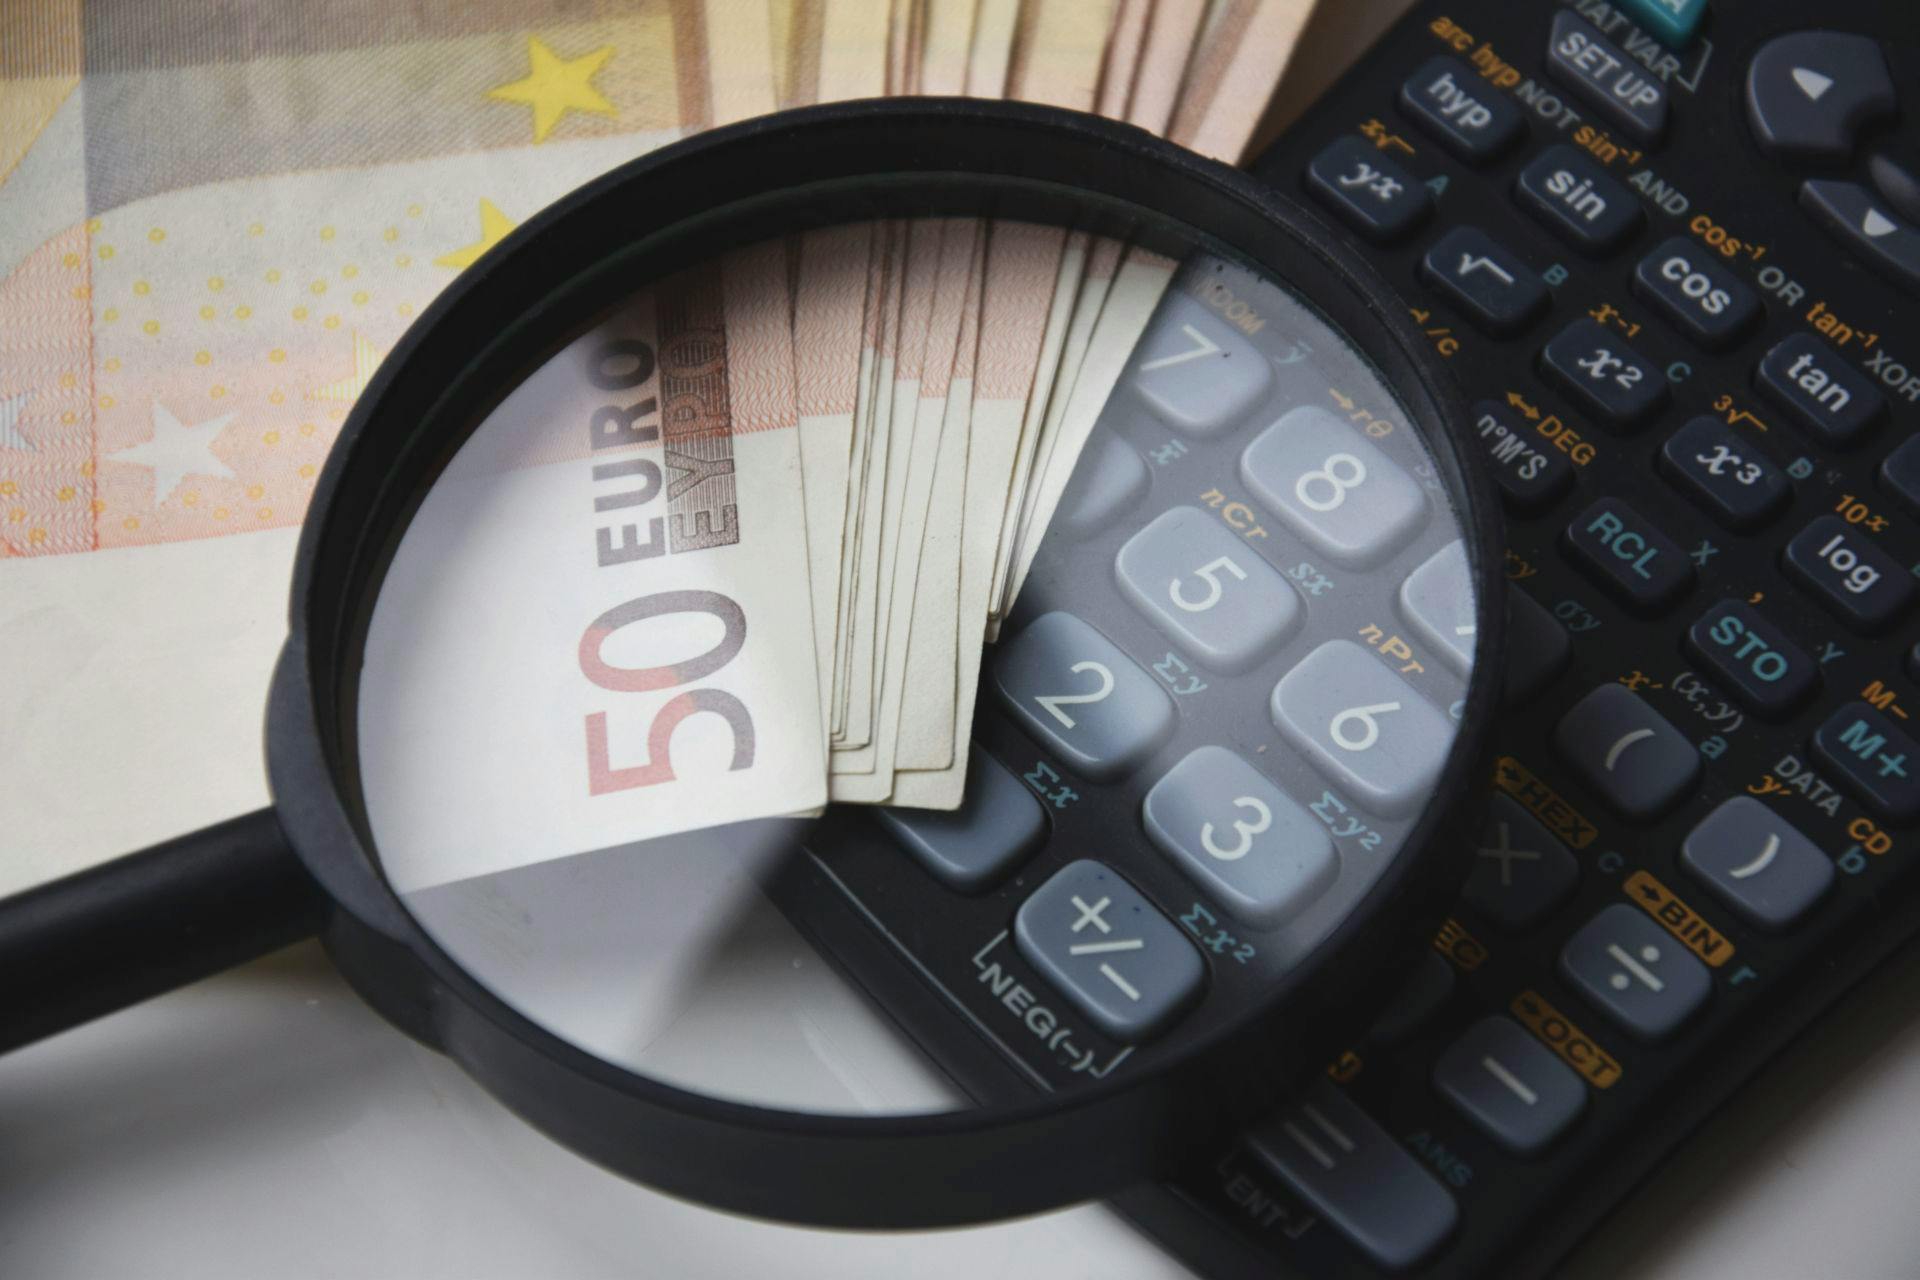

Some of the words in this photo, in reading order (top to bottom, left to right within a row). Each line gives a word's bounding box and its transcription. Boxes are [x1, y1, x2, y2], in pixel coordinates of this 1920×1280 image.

[1429, 16, 1474, 51] arc
[1470, 42, 1521, 89] hyp
[1558, 32, 1621, 79] SET
[1614, 71, 1660, 107] UP
[1624, 27, 1681, 83] VAR
[1427, 72, 1493, 129] hyp
[1515, 79, 1581, 129] NOT
[1426, 175, 1449, 195] A
[1545, 170, 1607, 220] sin
[1628, 169, 1690, 216] AND
[1543, 264, 1569, 286] B
[1661, 257, 1731, 314] cos
[1757, 266, 1805, 306] OR
[1139, 323, 1223, 372] 7
[1667, 361, 1691, 382] C
[1863, 349, 1920, 402] XOR
[1787, 354, 1850, 412] tan
[589, 338, 666, 567] EURO
[1536, 414, 1597, 466] DEG
[1296, 453, 1367, 512] 8
[1786, 457, 1814, 480] D
[1200, 487, 1268, 539] nCr
[1586, 511, 1658, 580] RCL
[1818, 534, 1881, 594] log
[1169, 556, 1248, 612] 5
[1358, 623, 1424, 675] nPr
[1709, 616, 1789, 682] STO
[578, 589, 756, 797] 50
[1034, 661, 1115, 729] 2
[1330, 701, 1401, 751] 6
[1838, 719, 1908, 778] M+
[1774, 755, 1843, 817] DATA
[1201, 796, 1272, 861] 3
[1847, 816, 1893, 856] CD
[1657, 903, 1724, 959] BIN
[1540, 1018, 1617, 1079] OCT
